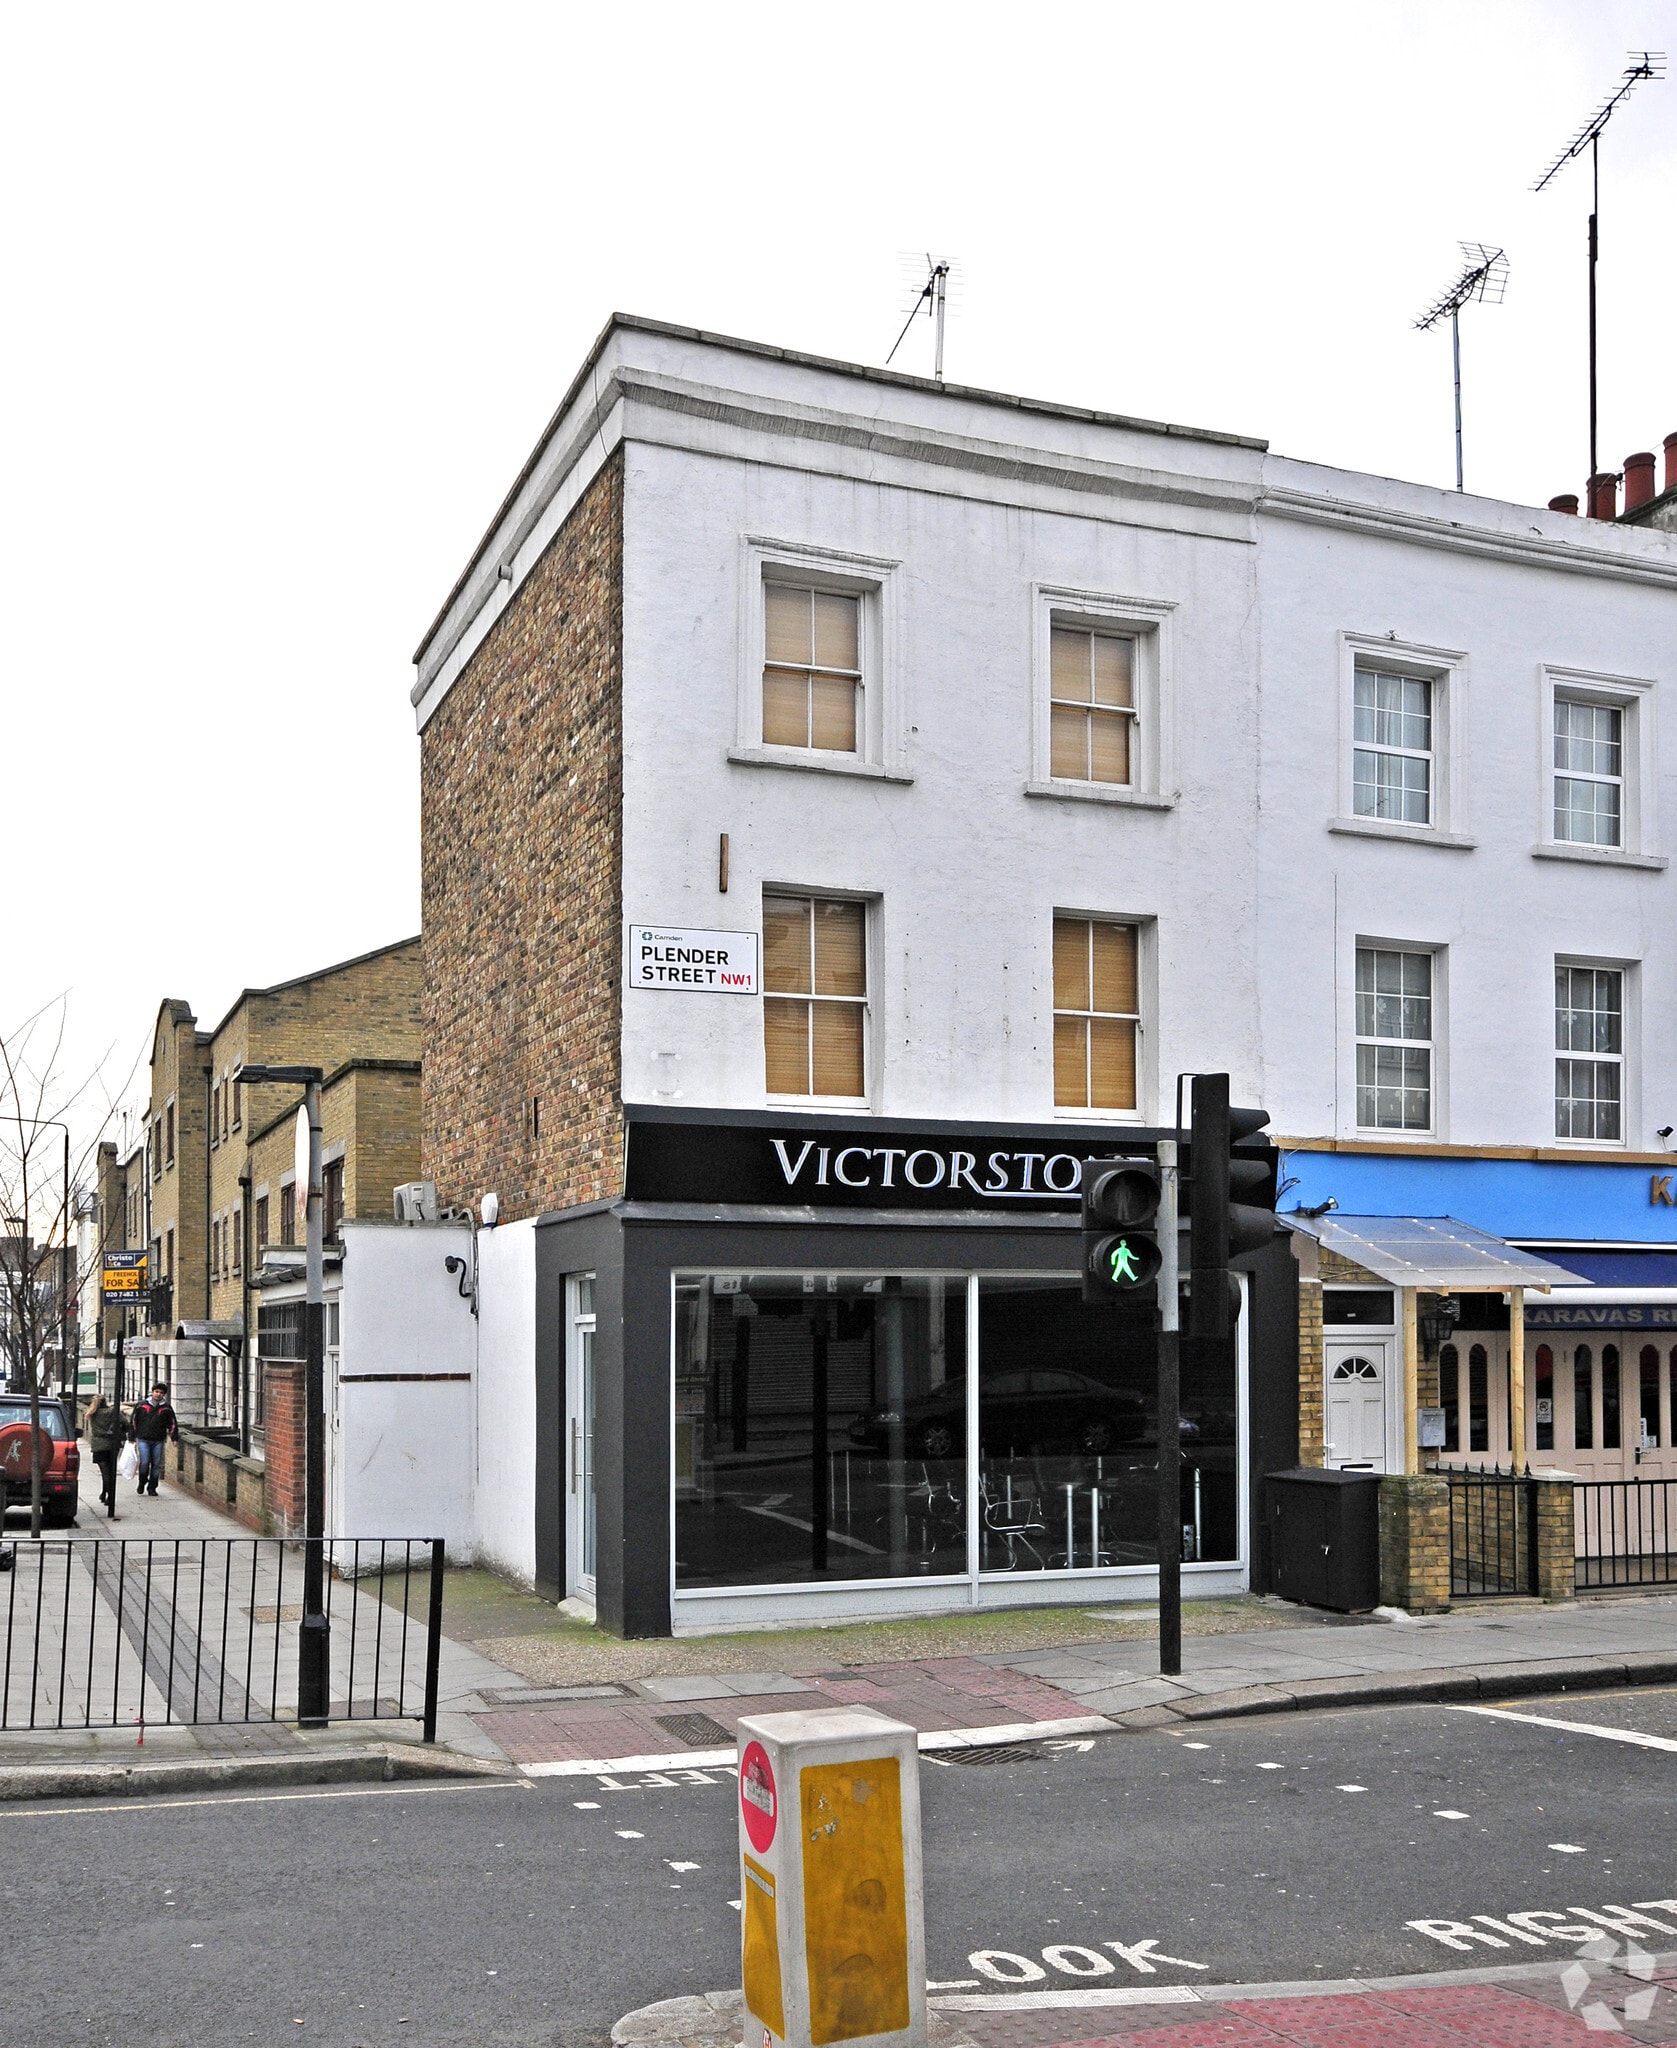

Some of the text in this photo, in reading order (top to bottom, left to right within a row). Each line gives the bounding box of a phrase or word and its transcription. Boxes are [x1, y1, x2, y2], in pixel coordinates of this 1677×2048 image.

[654, 934, 683, 942] Camden
[641, 946, 729, 965] PLENDER
[642, 965, 751, 986] STREET NW1
[769, 1139, 1149, 1198] VICTORSTO
[106, 1279, 124, 1287] FOR
